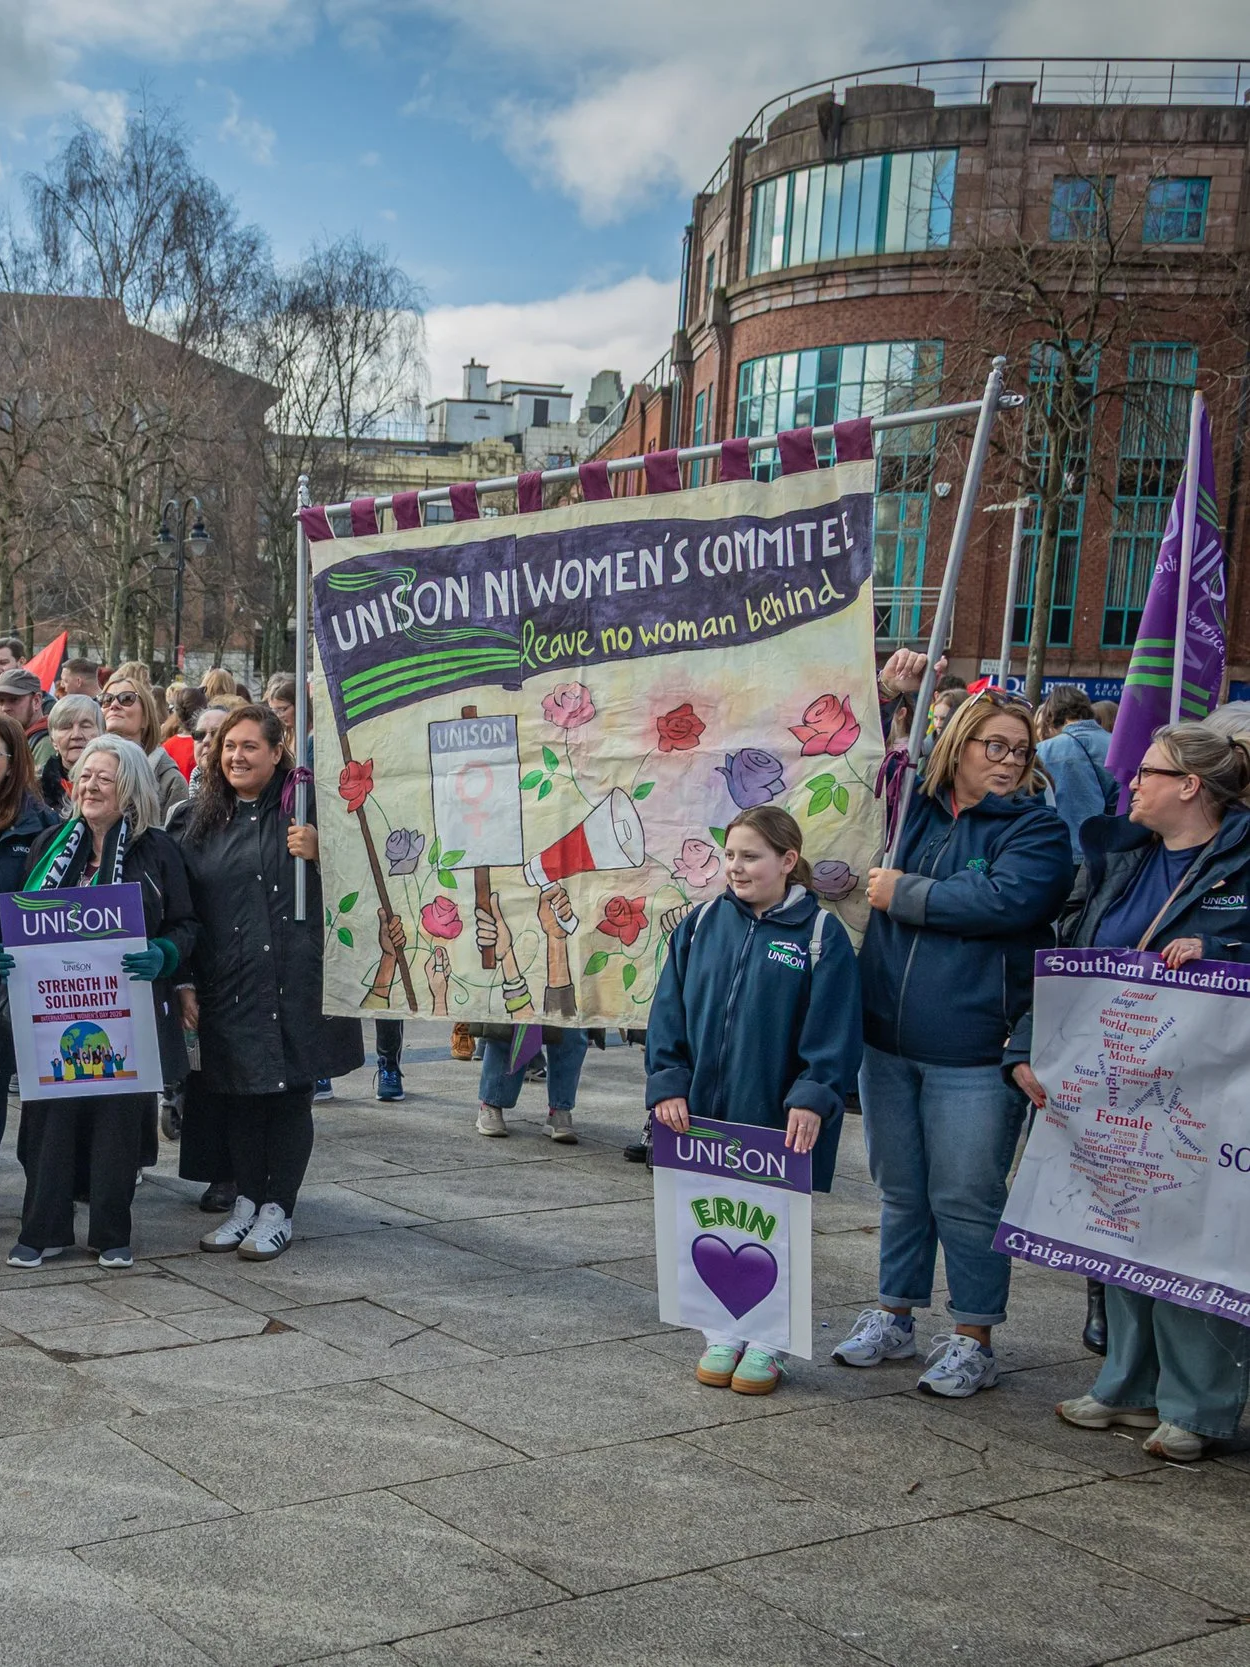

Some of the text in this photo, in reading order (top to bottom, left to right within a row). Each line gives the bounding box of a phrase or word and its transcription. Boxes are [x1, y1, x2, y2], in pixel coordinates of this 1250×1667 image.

[331, 510, 854, 651] UNISON NI WOMEN'S COMMITEE
[520, 568, 845, 669] leave no woman behind
[436, 722, 506, 749] UNISON
[40, 830, 80, 890] GAZA
[1202, 895, 1245, 905] UNISON
[22, 907, 122, 936] UNISON
[64, 962, 91, 972] UNISON
[768, 950, 805, 969] UNISON
[1051, 955, 1144, 978] Southern
[38, 976, 118, 994] STRENGTH IN
[45, 991, 117, 1009] SOLIDARITY
[1121, 988, 1158, 1001] demand
[1111, 997, 1138, 1008] change
[40, 1013, 76, 1022] INTERNATIONAL
[1101, 1008, 1158, 1023] achievements
[1100, 1016, 1155, 1038] world equal
[1139, 1016, 1176, 1053] Scientist
[1103, 1030, 1124, 1040] Social
[1103, 1039, 1135, 1052] Writer
[1109, 1051, 1147, 1065] Mother
[1074, 1065, 1099, 1078] Sister
[1154, 1066, 1174, 1080] day
[1061, 1081, 1083, 1093] Wife
[1105, 1066, 1120, 1107] rights
[1122, 1077, 1149, 1087] power
[1056, 1092, 1082, 1104] artist
[1095, 1108, 1153, 1131] Female
[1169, 1115, 1206, 1129] Courage
[1085, 1129, 1137, 1146] history vision
[1110, 1128, 1138, 1139] dreams
[1173, 1125, 1201, 1154] Support
[1084, 1143, 1127, 1158] confidence
[1110, 1142, 1136, 1152] career
[677, 1136, 785, 1179] UNISON
[1099, 1153, 1160, 1170] empowerment
[1146, 1151, 1164, 1160] vote
[1176, 1150, 1208, 1163] human
[1107, 1170, 1148, 1185] Awareness
[1109, 1164, 1141, 1175] creative
[1144, 1168, 1175, 1181] Sports
[1124, 1182, 1148, 1194] Carer
[1152, 1181, 1182, 1195] gender
[690, 1197, 776, 1242] ERIN
[1088, 1205, 1115, 1222] ribbons
[1094, 1218, 1128, 1232] activist
[1085, 1223, 1135, 1243] international
[1007, 1232, 1111, 1276] Craigavon
[1114, 1263, 1206, 1303] Hospitals
